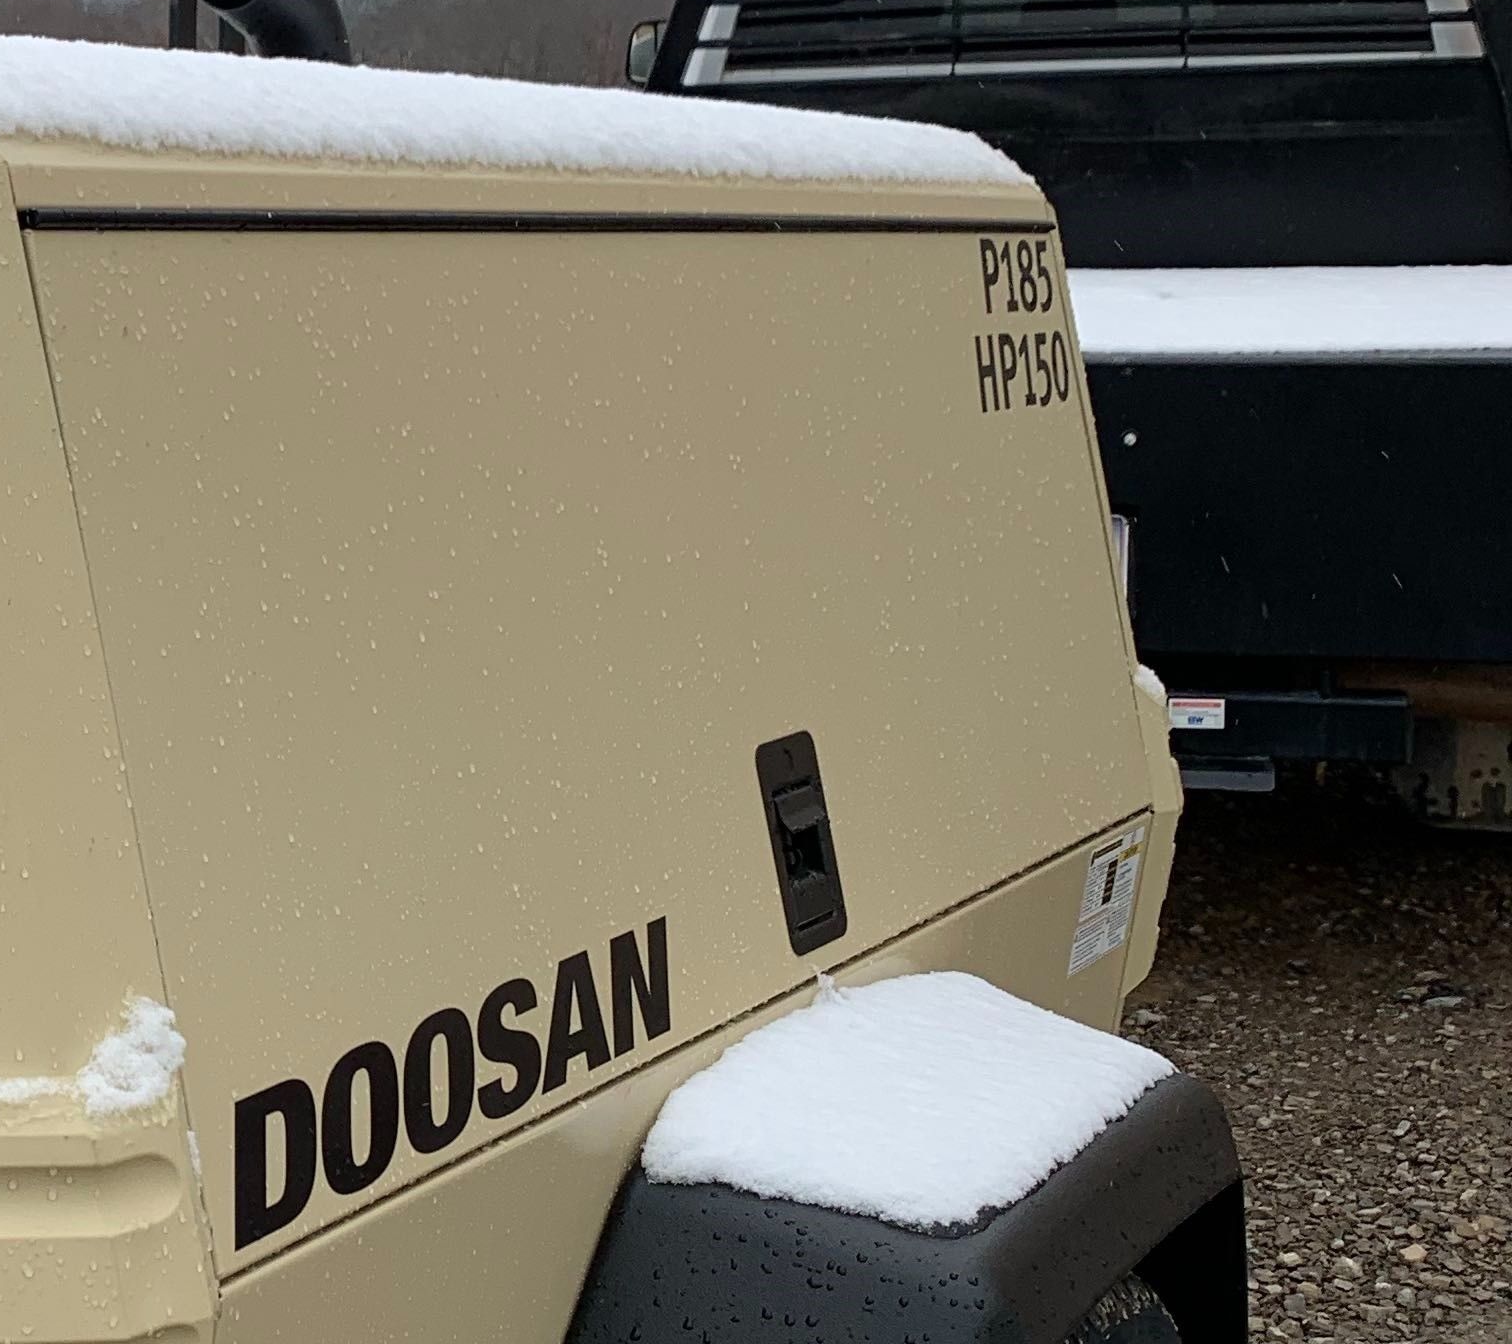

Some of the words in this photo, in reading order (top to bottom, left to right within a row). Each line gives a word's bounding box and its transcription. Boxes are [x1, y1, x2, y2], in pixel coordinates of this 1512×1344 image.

[979, 238, 1053, 314] P185
[975, 330, 1069, 413] HP150
[234, 915, 671, 1253] DOOSAN
